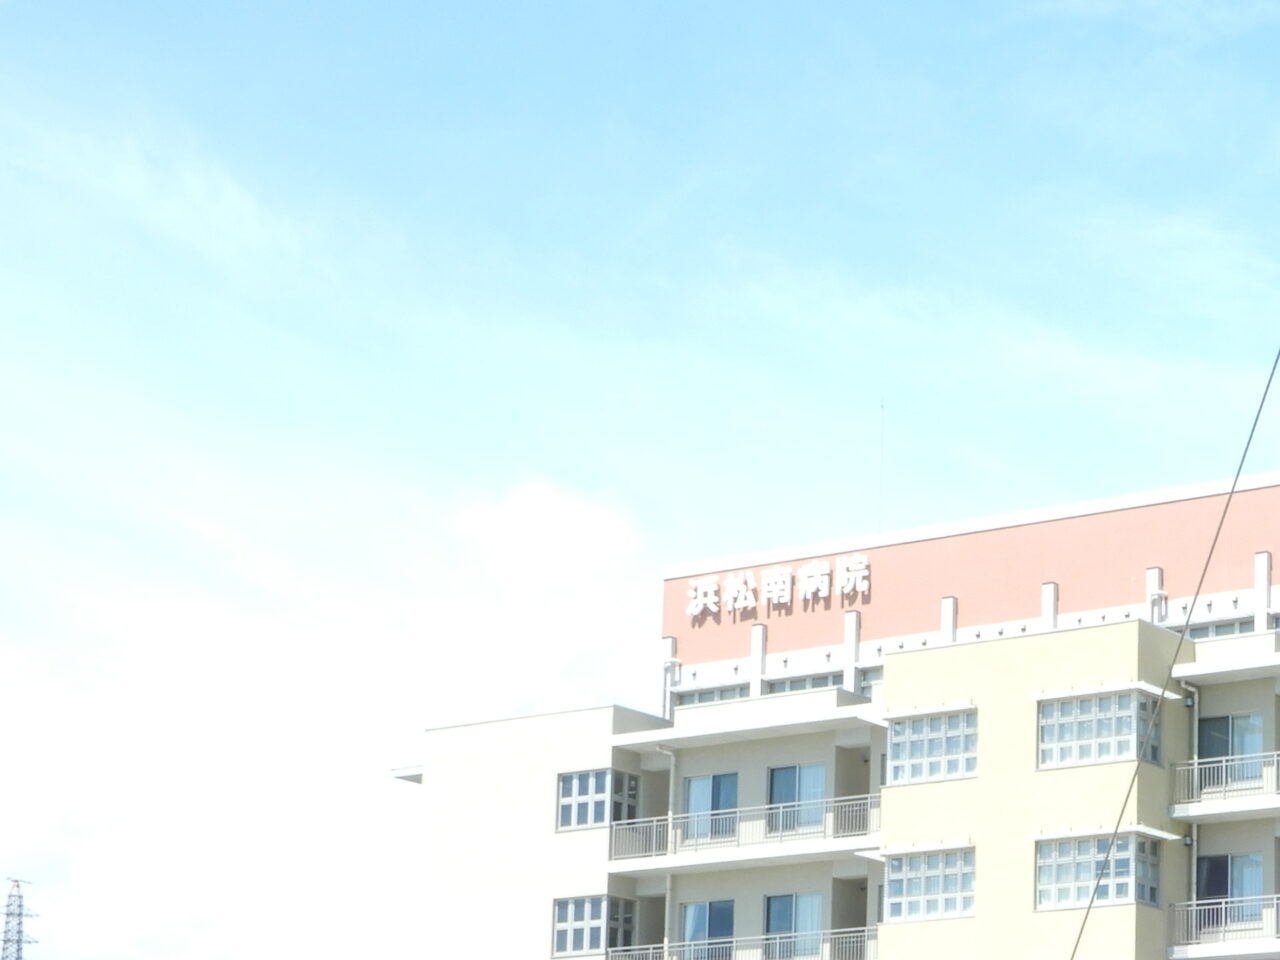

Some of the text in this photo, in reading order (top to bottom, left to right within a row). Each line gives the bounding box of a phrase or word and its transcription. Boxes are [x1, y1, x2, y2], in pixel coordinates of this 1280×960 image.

[686, 554, 870, 616] 浜松南病院
